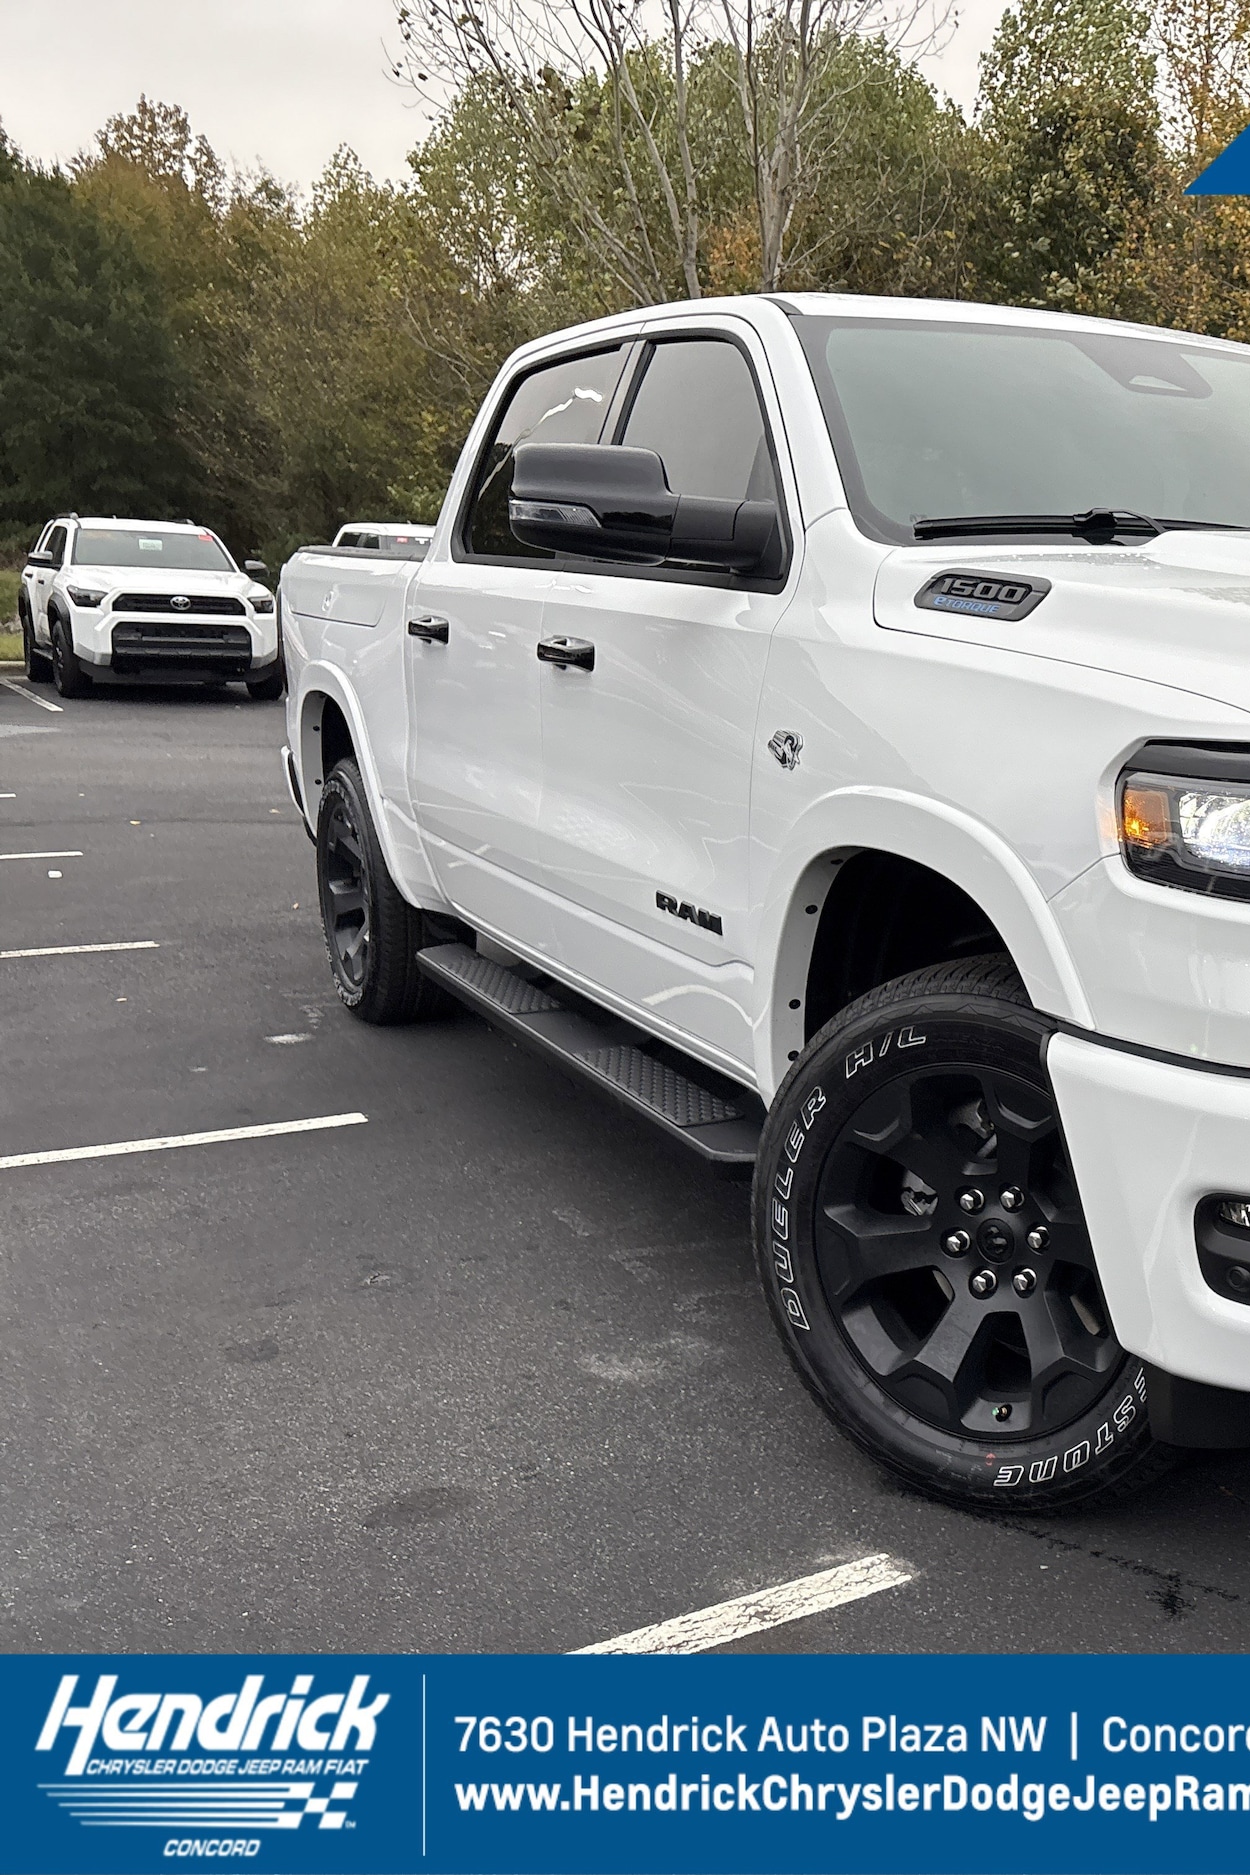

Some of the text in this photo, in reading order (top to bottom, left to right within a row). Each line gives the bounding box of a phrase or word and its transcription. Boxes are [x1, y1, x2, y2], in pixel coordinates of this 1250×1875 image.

[940, 577, 1027, 602] 1500
[655, 889, 724, 937] RAM
[772, 1026, 927, 1331] DUELER H/L
